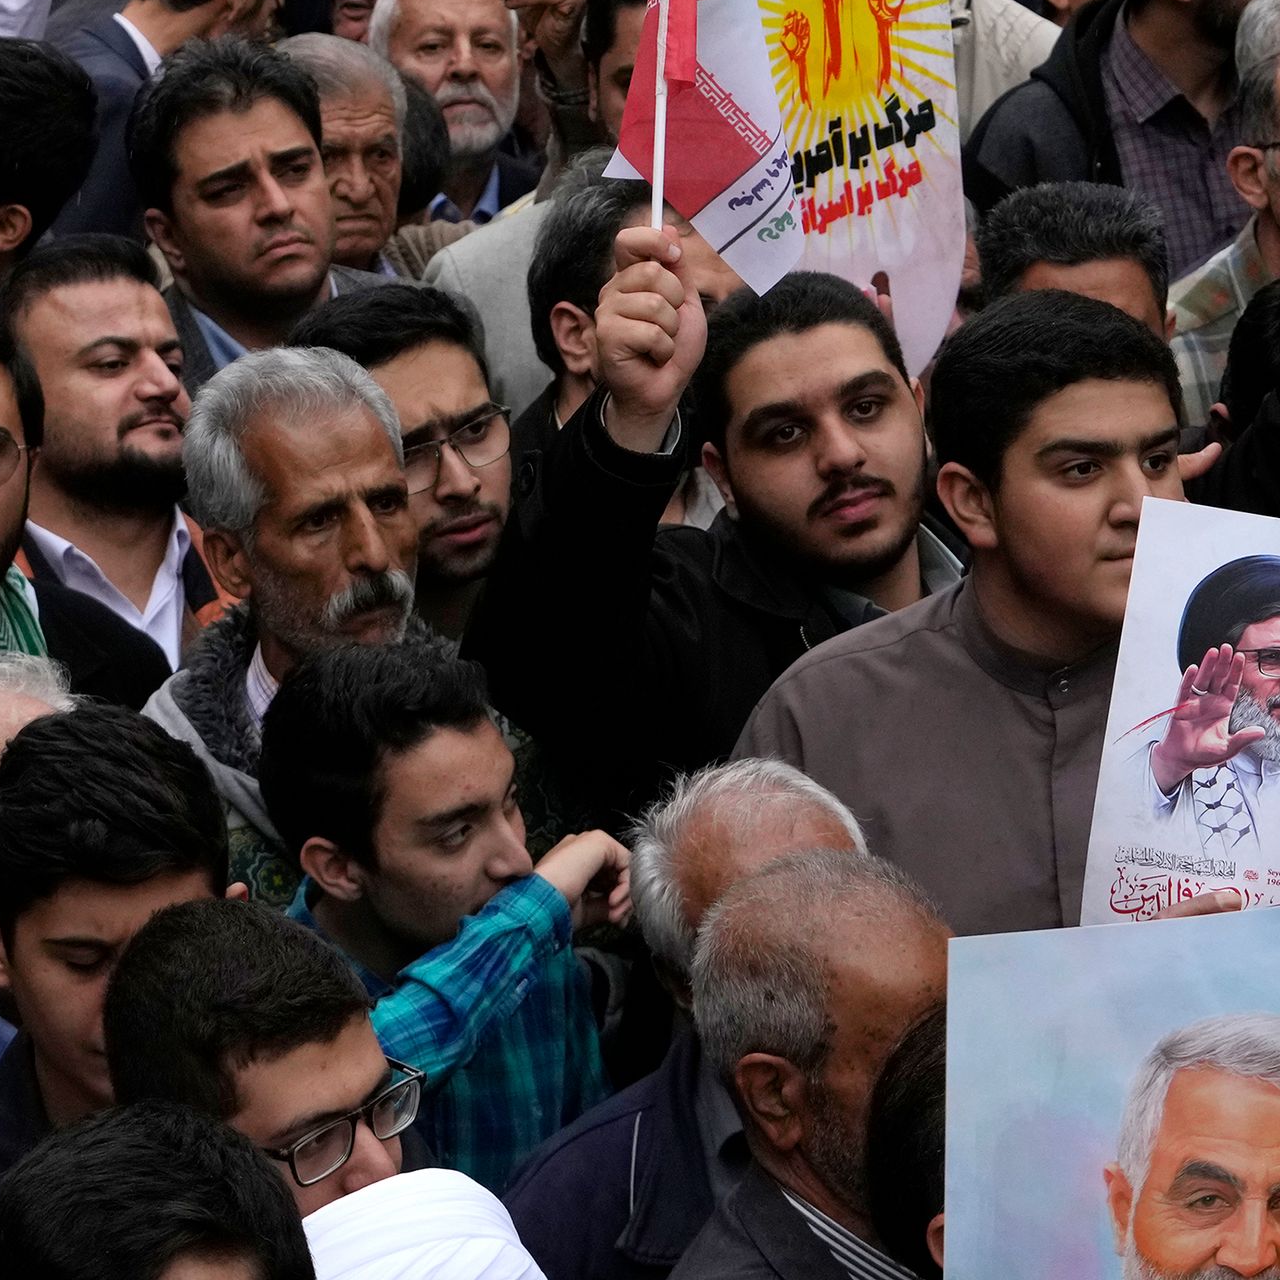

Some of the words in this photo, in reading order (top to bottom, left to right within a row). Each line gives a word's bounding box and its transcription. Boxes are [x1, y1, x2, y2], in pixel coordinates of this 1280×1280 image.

[874, 92, 936, 150] مرگ
[848, 123, 872, 169] بر
[856, 181, 874, 216] بر
[875, 155, 923, 200] مرگ
